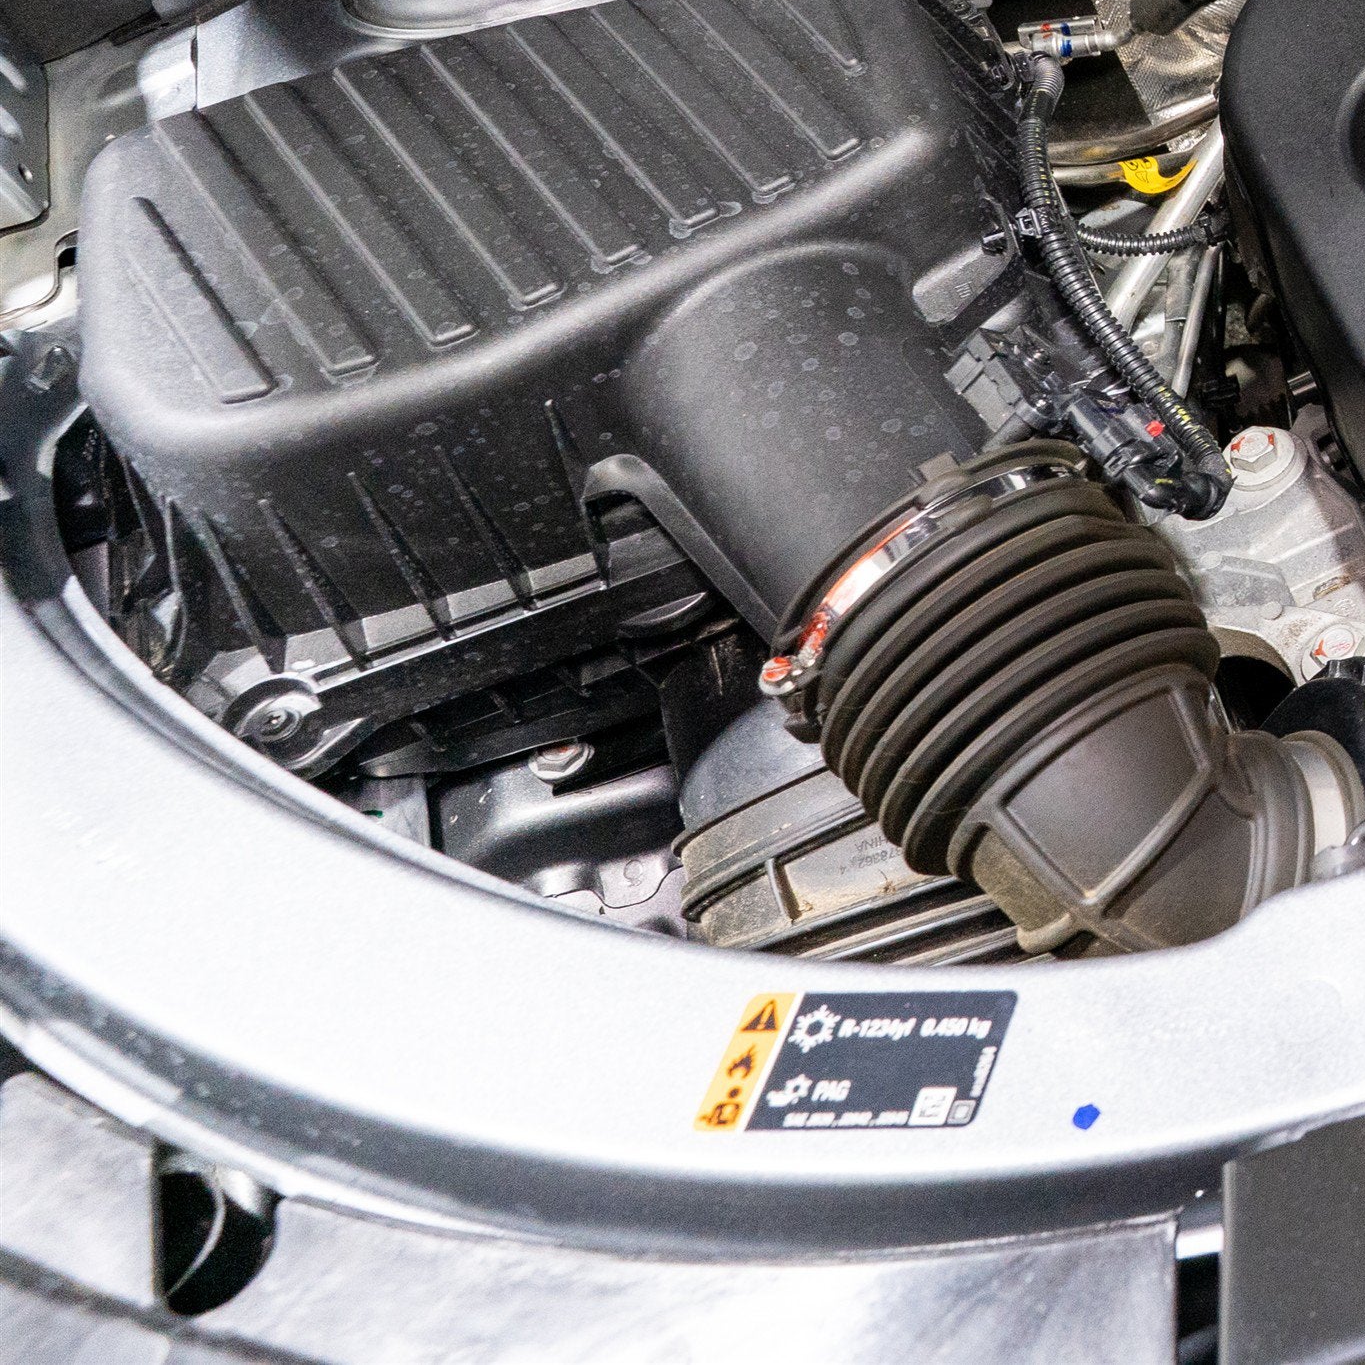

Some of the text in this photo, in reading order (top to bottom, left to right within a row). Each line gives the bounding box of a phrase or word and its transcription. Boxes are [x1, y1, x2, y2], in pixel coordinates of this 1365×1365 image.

[837, 1017, 917, 1041] R-1234yf
[967, 1016, 993, 1040] kg
[811, 1079, 851, 1102] PAG
